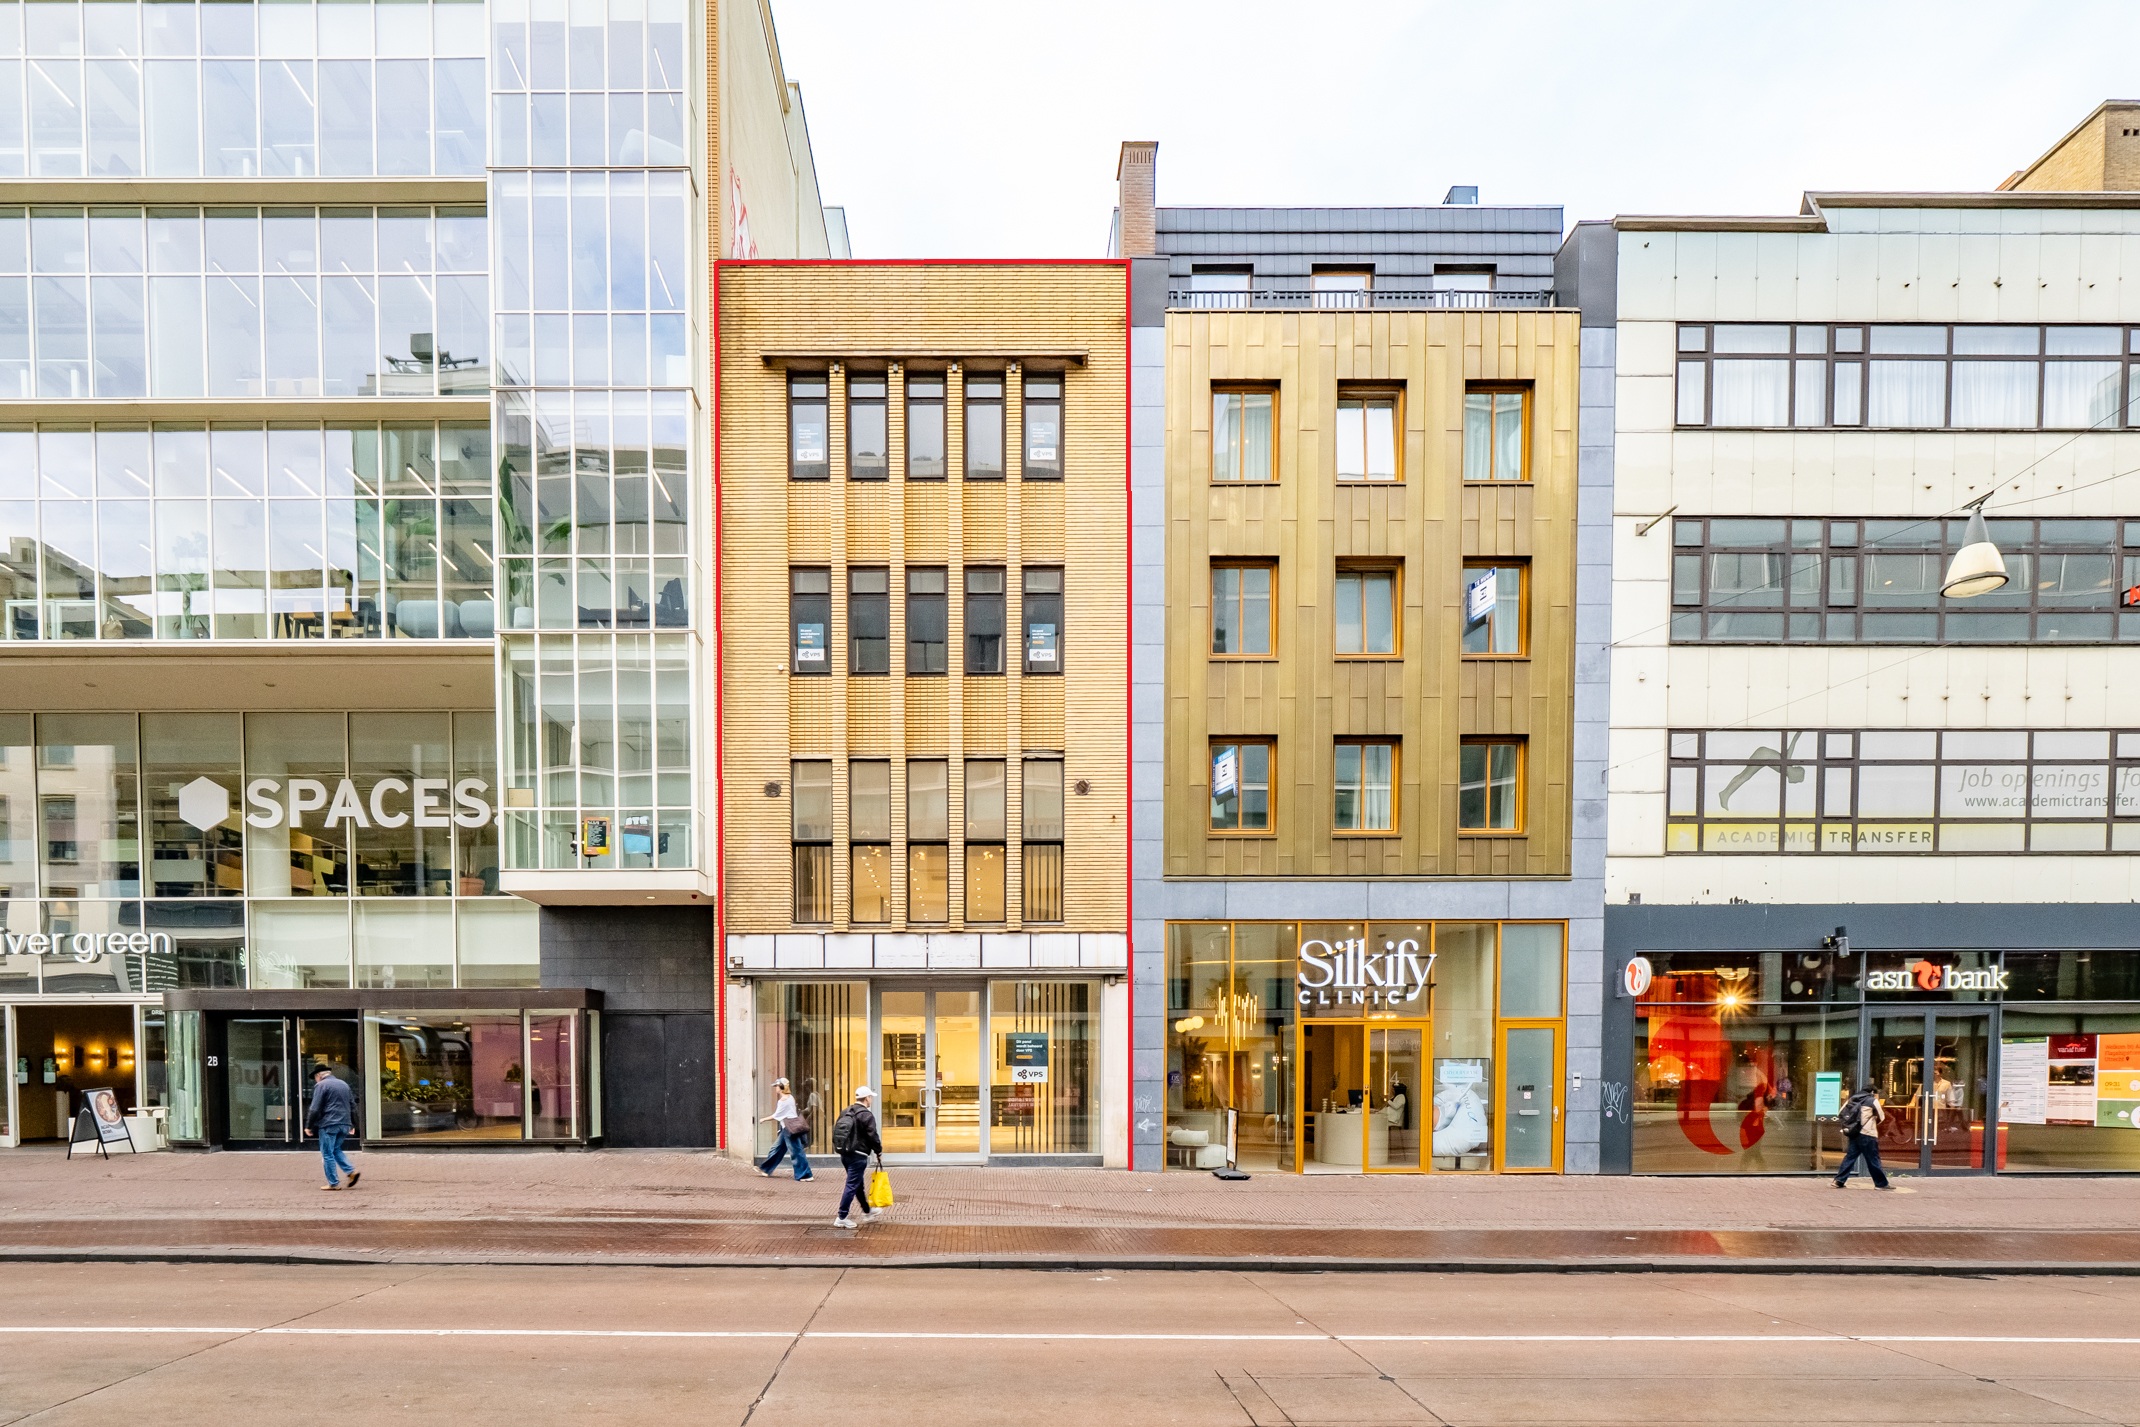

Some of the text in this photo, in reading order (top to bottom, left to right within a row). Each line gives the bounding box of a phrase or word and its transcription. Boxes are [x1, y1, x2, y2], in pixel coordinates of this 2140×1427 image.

[1958, 768, 1993, 793] Job
[2001, 769, 2101, 793] openings
[1717, 831, 1931, 843] ACADEMIC TRANSFER
[72, 932, 173, 963] green
[1298, 938, 1437, 1001] Silkify
[1867, 965, 2009, 989] asn bank
[1298, 990, 1401, 1004] CLINIC
[207, 1056, 219, 1067] 2B
